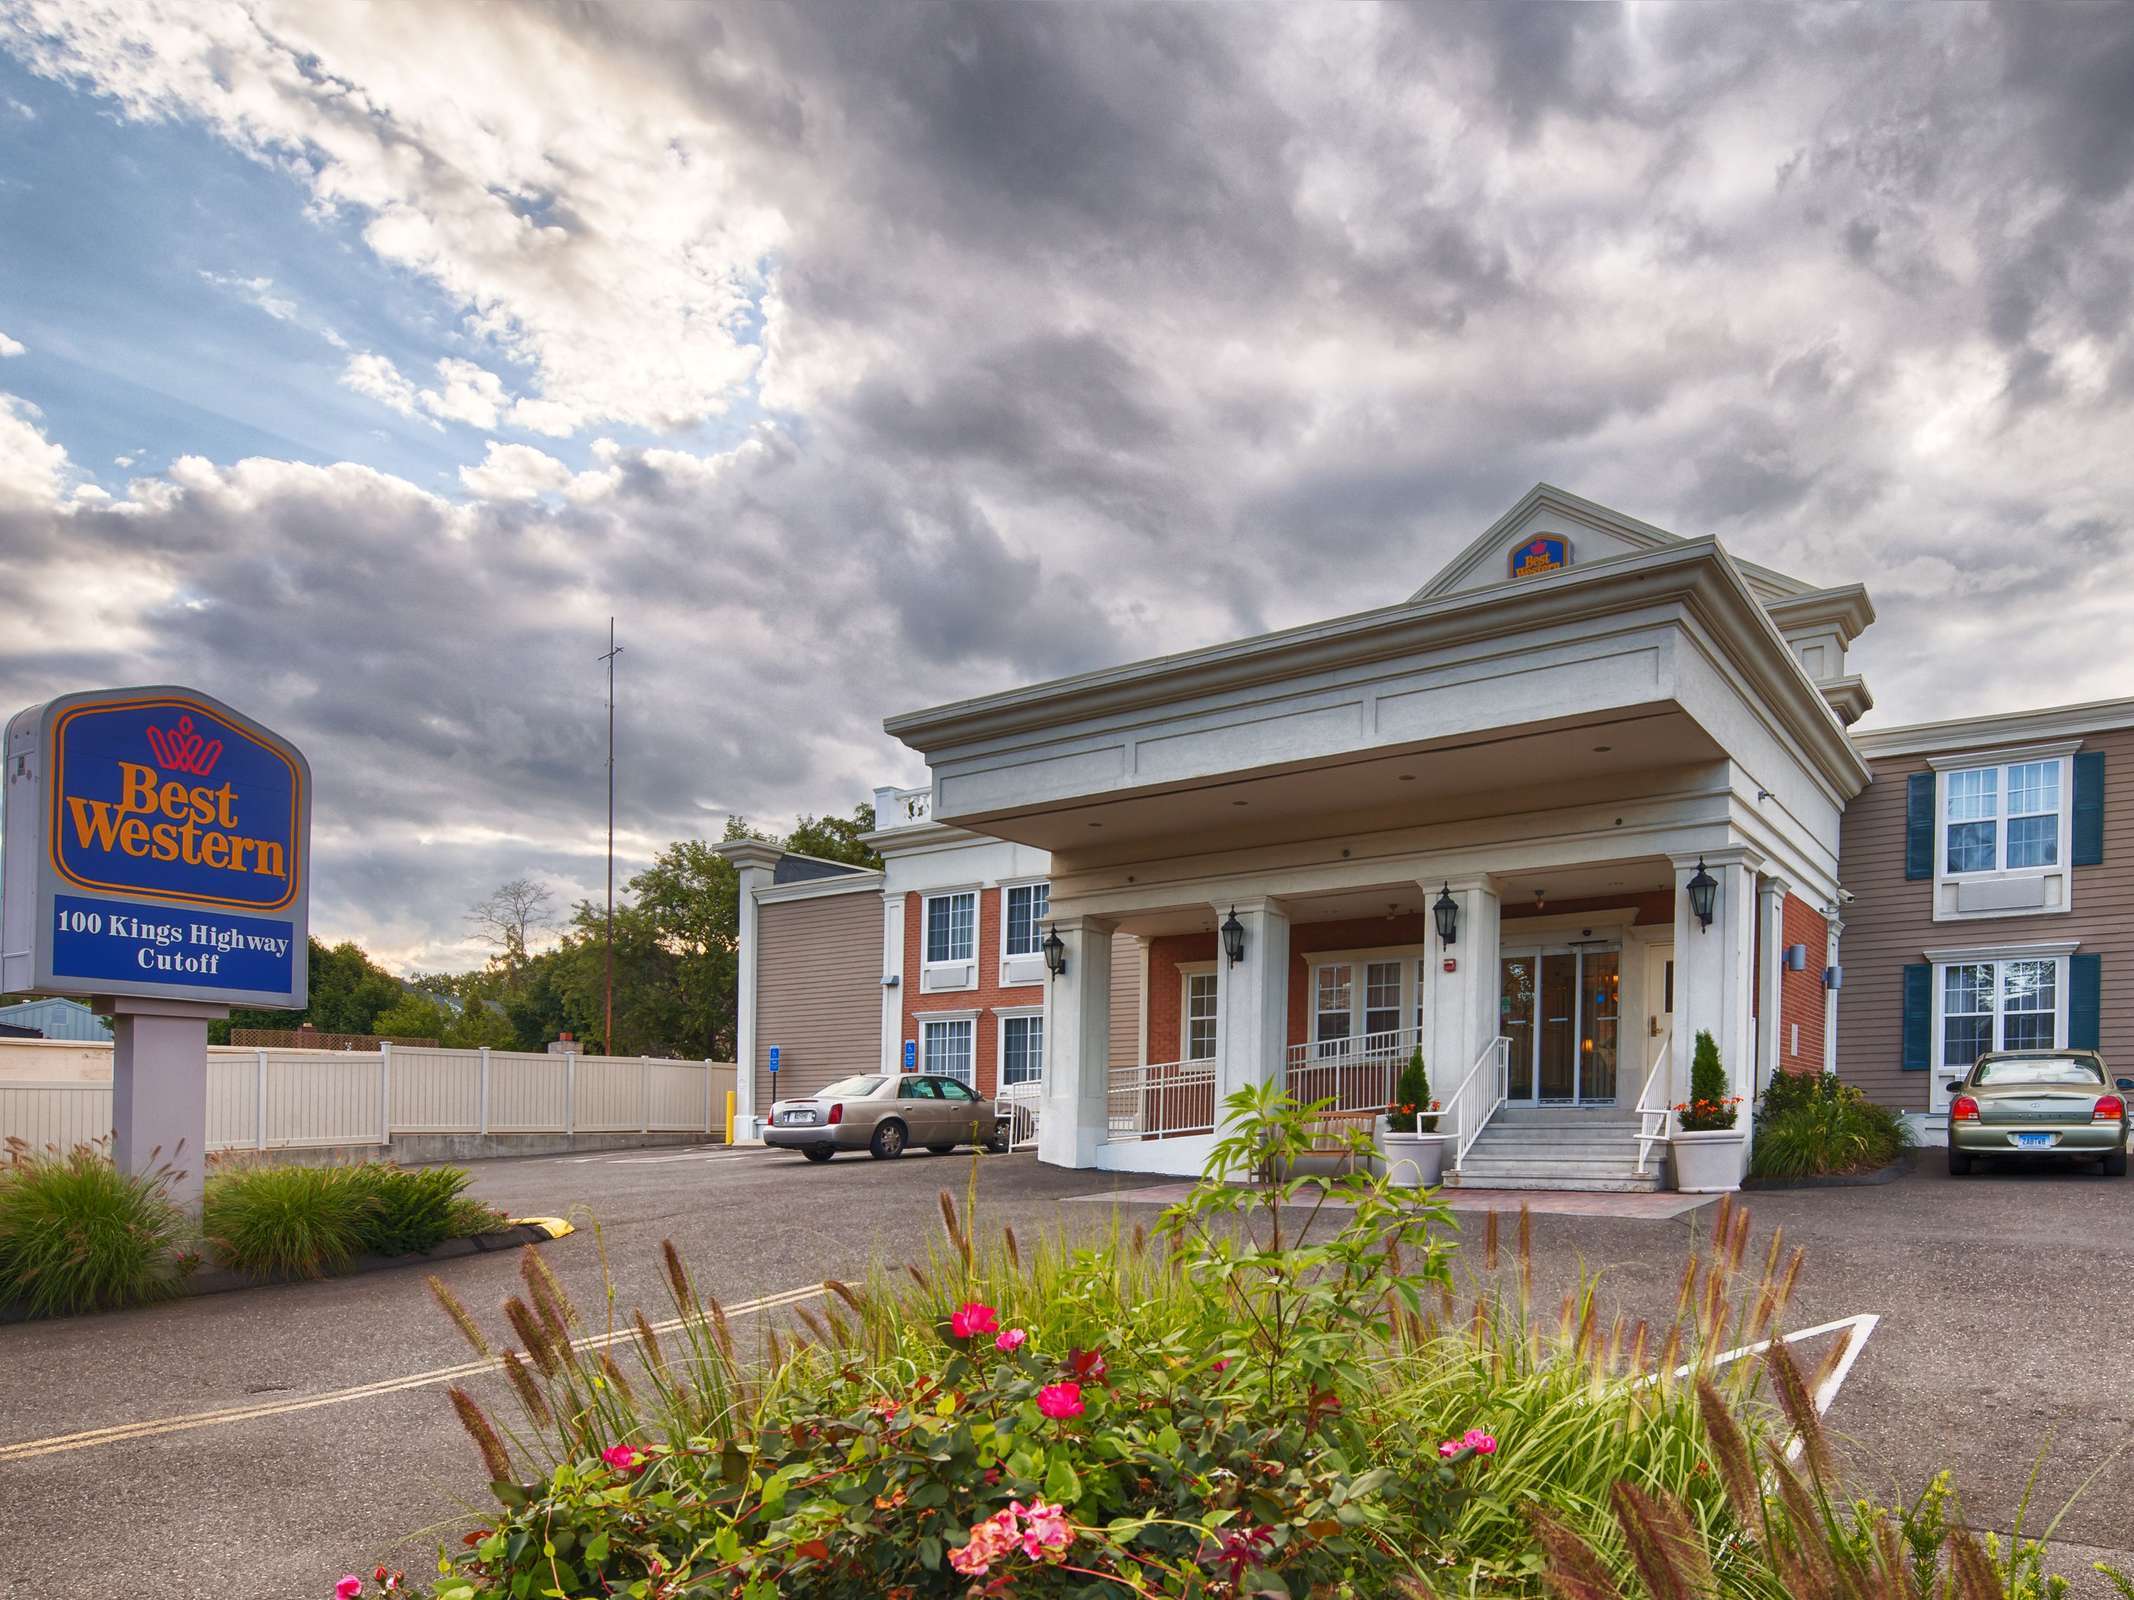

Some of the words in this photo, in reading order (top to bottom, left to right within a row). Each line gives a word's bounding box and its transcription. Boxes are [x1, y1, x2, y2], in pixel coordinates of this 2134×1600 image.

[118, 761, 239, 829] Best
[66, 796, 287, 878] Western
[58, 910, 102, 934] 100
[108, 914, 183, 947] Kings
[189, 923, 289, 958] Highway
[137, 947, 220, 975] Cutoff
